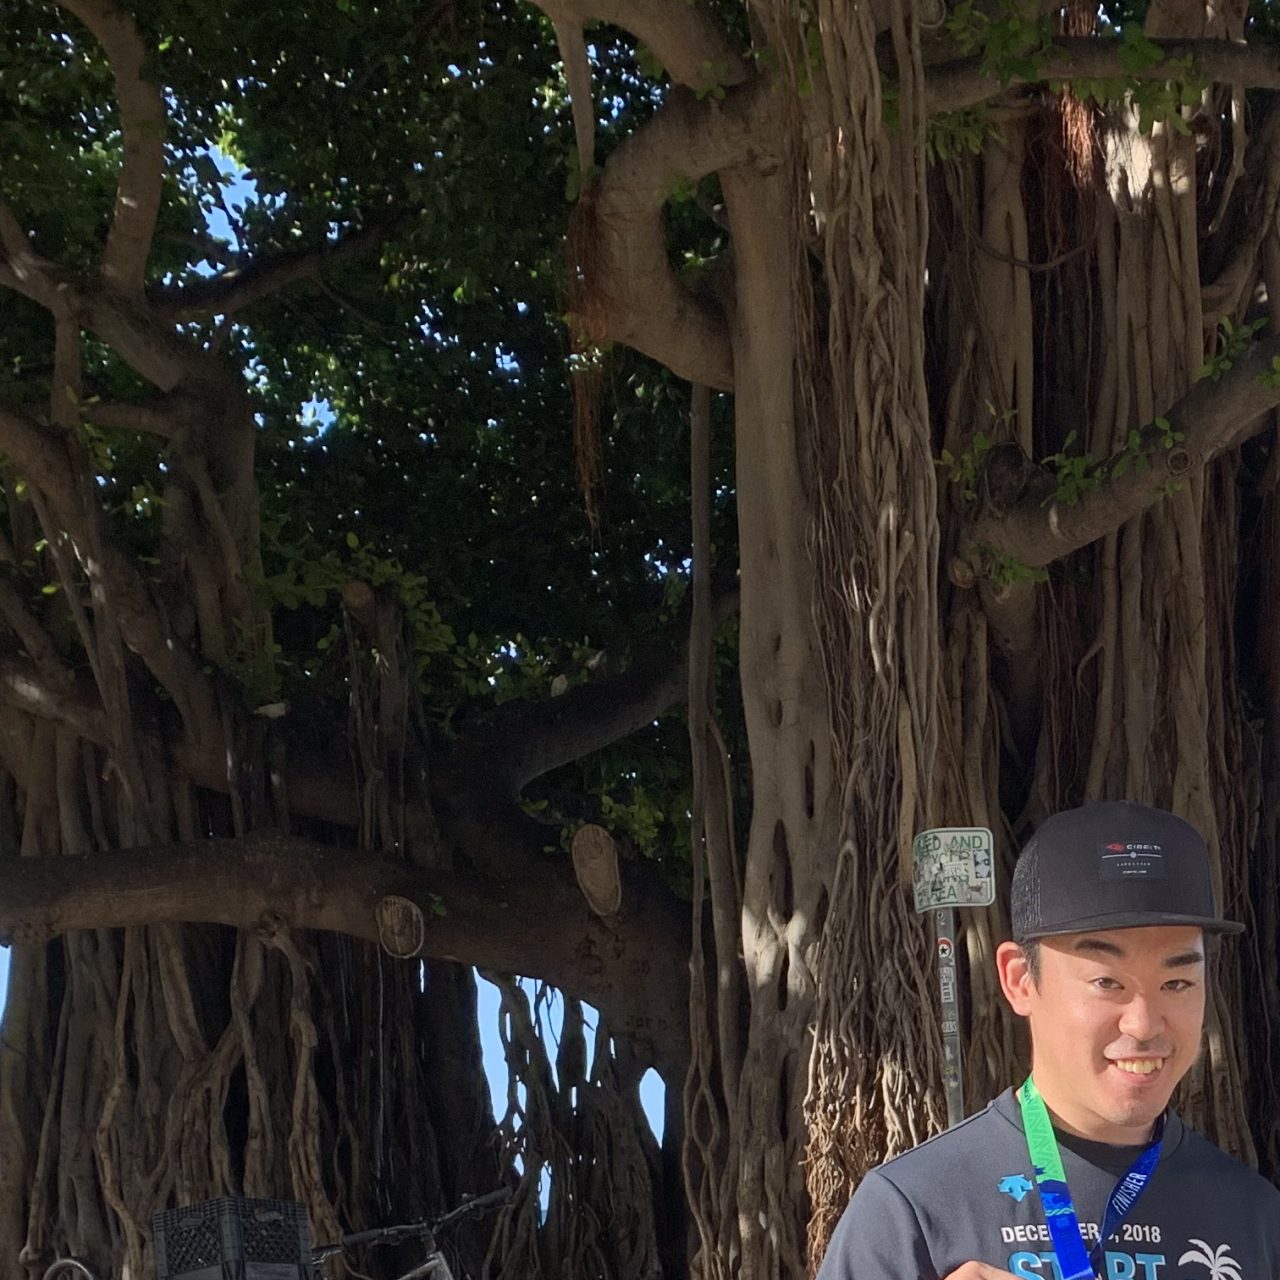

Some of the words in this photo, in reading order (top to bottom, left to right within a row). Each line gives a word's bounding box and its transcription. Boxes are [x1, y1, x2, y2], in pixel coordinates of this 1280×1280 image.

[951, 835, 983, 849] AND
[1112, 1172, 1147, 1216] FINISHER
[1001, 1223, 1099, 1243] DECEER
[1124, 1224, 1161, 1243] 2018
